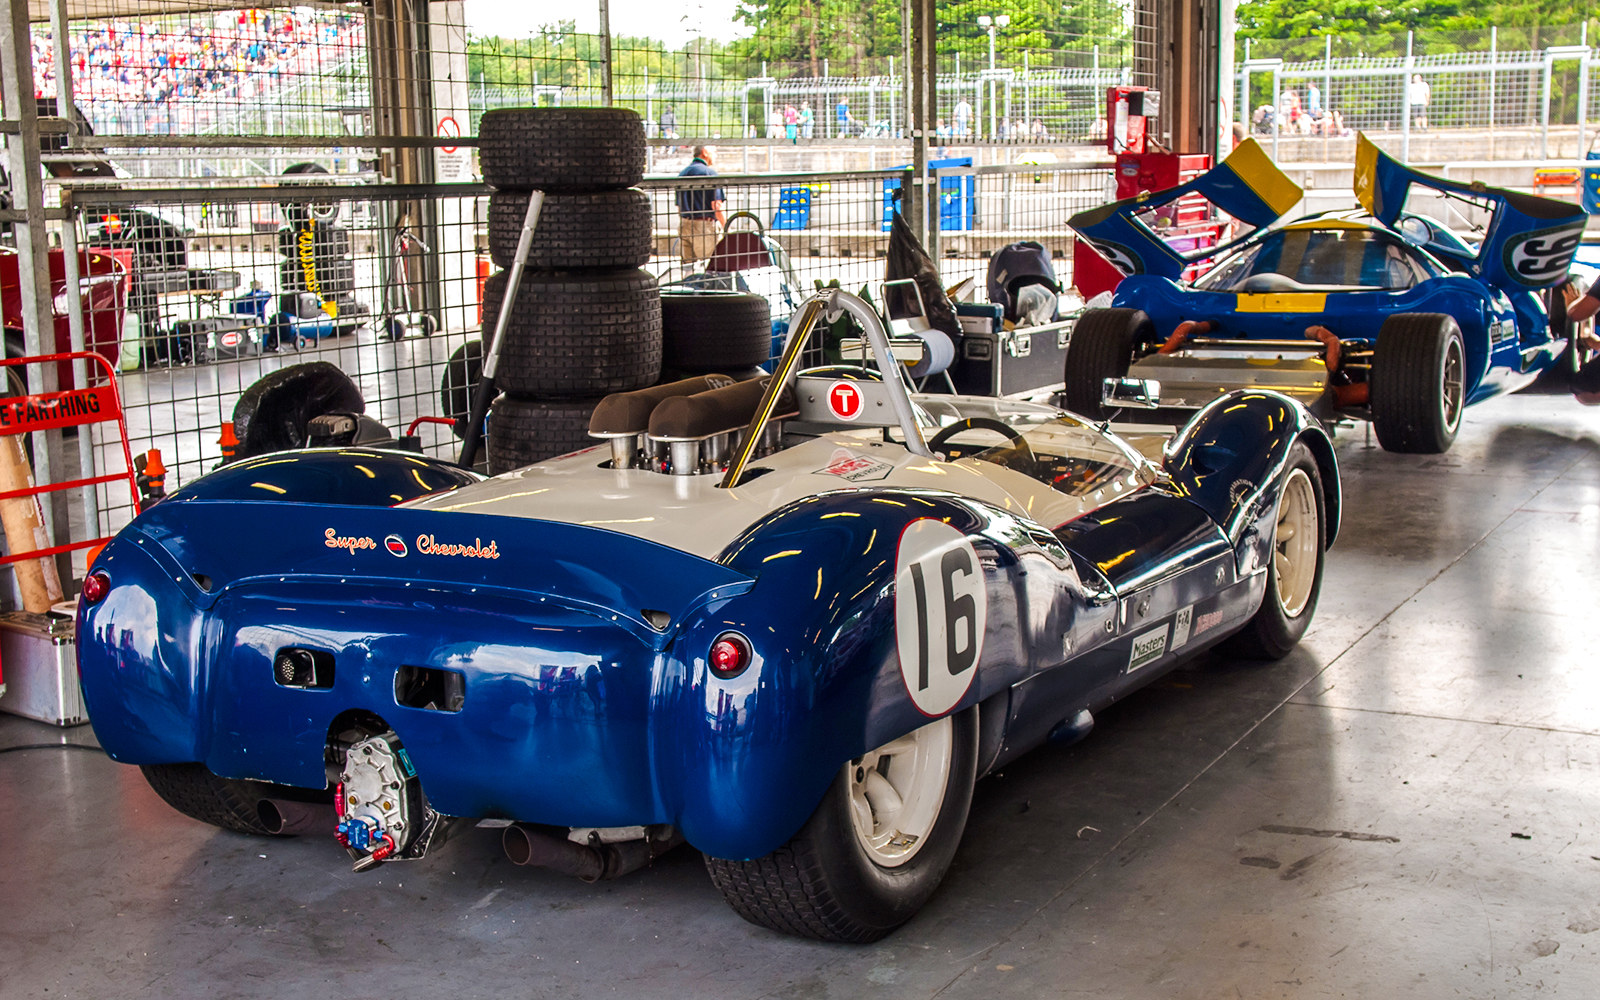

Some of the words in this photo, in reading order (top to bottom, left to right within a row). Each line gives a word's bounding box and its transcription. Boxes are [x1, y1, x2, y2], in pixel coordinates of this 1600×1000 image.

[15, 393, 101, 424] FARTHING
[835, 389, 854, 412] T
[324, 527, 377, 556] Super
[416, 533, 501, 560] Chevrolet
[909, 546, 977, 692] 16
[1132, 634, 1166, 660] Masters
